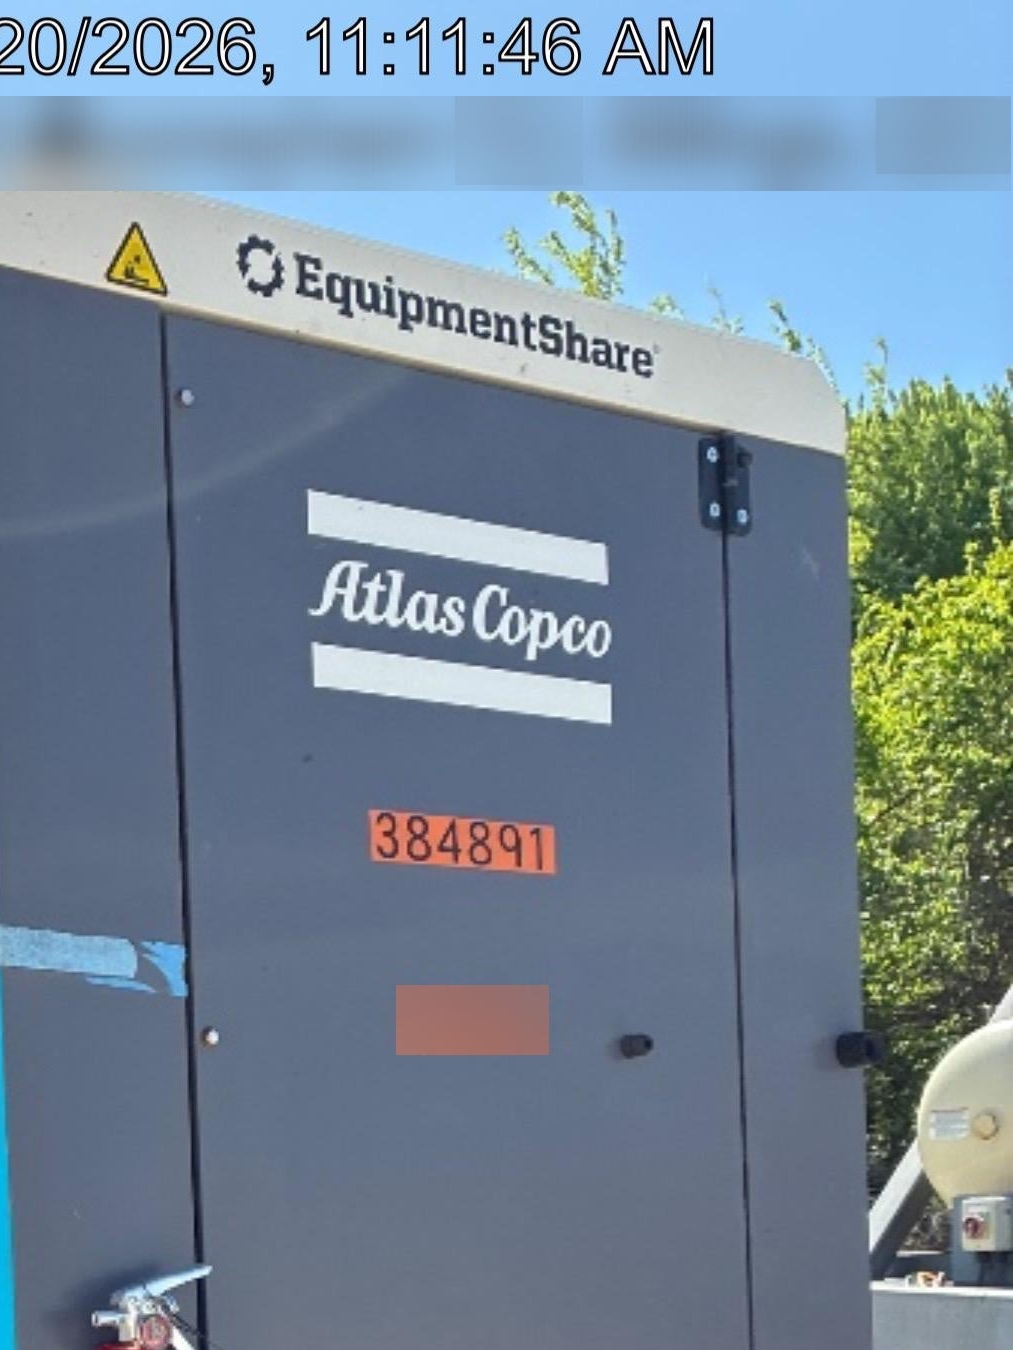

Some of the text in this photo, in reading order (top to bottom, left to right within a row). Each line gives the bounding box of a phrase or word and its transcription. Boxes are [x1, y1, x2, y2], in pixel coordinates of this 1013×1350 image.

[294, 252, 654, 378] EquipmentShare
[308, 559, 612, 661] Atlas Copco
[376, 811, 544, 871] 384891
